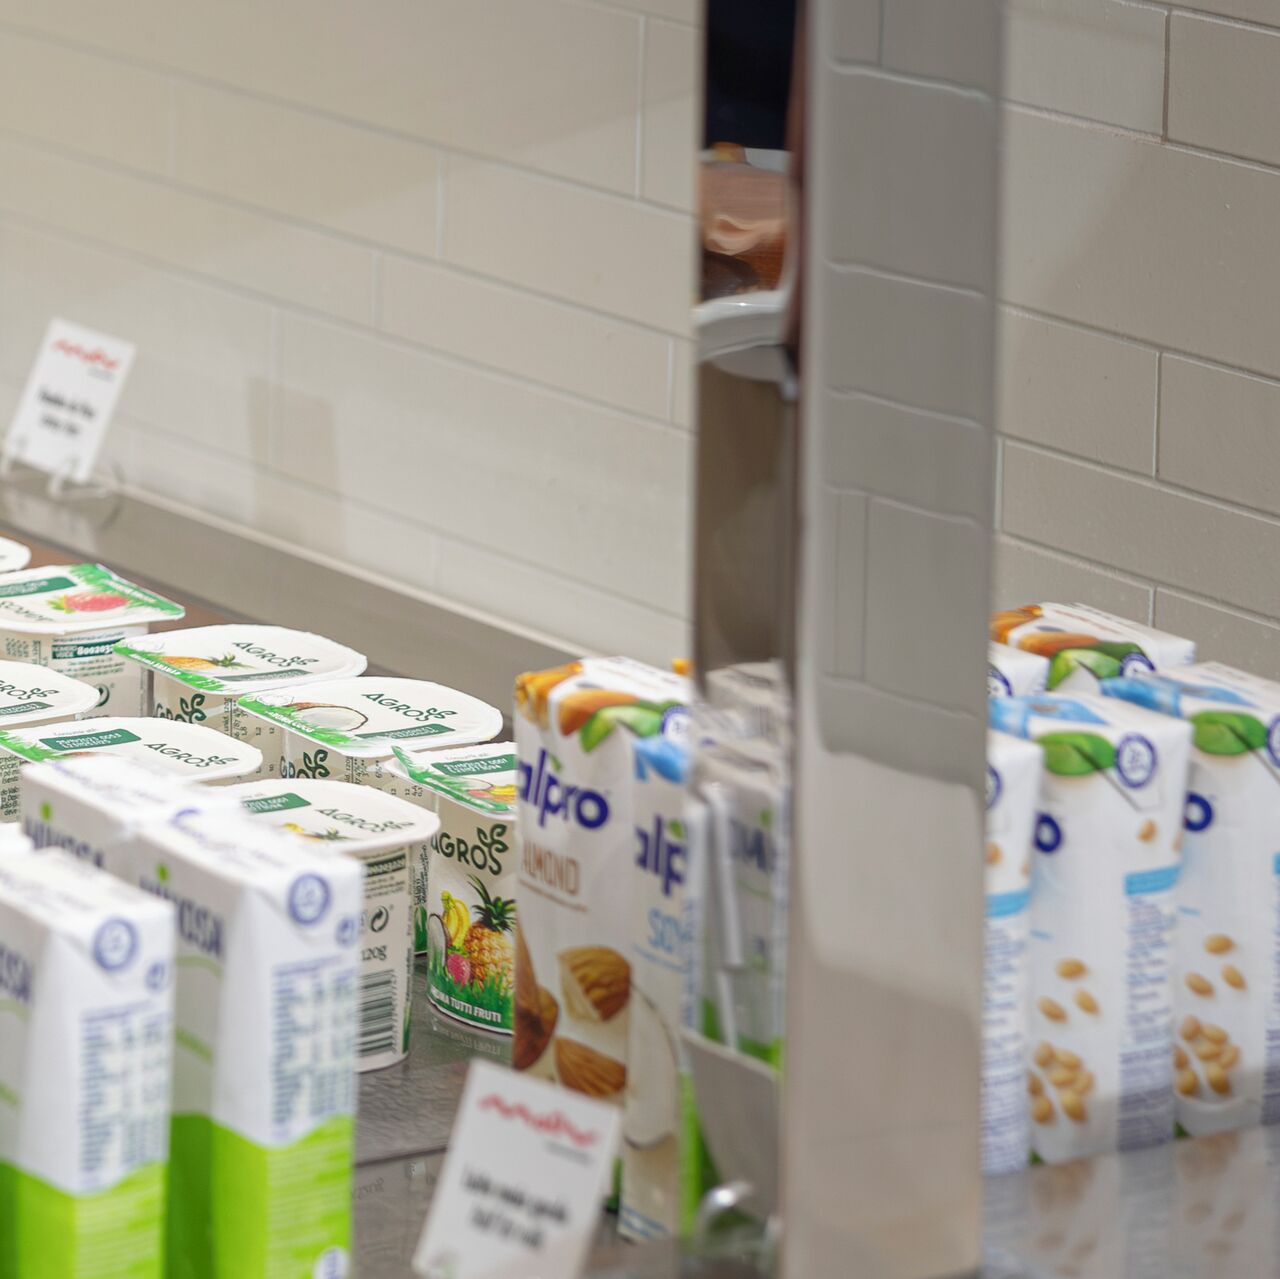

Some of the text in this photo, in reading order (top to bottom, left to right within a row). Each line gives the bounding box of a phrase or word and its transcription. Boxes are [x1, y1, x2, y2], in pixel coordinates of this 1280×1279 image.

[232, 641, 319, 668] AGROS
[362, 692, 458, 722] AGROS
[143, 742, 239, 769] AGROS
[518, 749, 609, 829] alpro
[431, 823, 509, 876] AGROS
[635, 814, 686, 897] alp
[450, 995, 473, 1015] TUTTI
